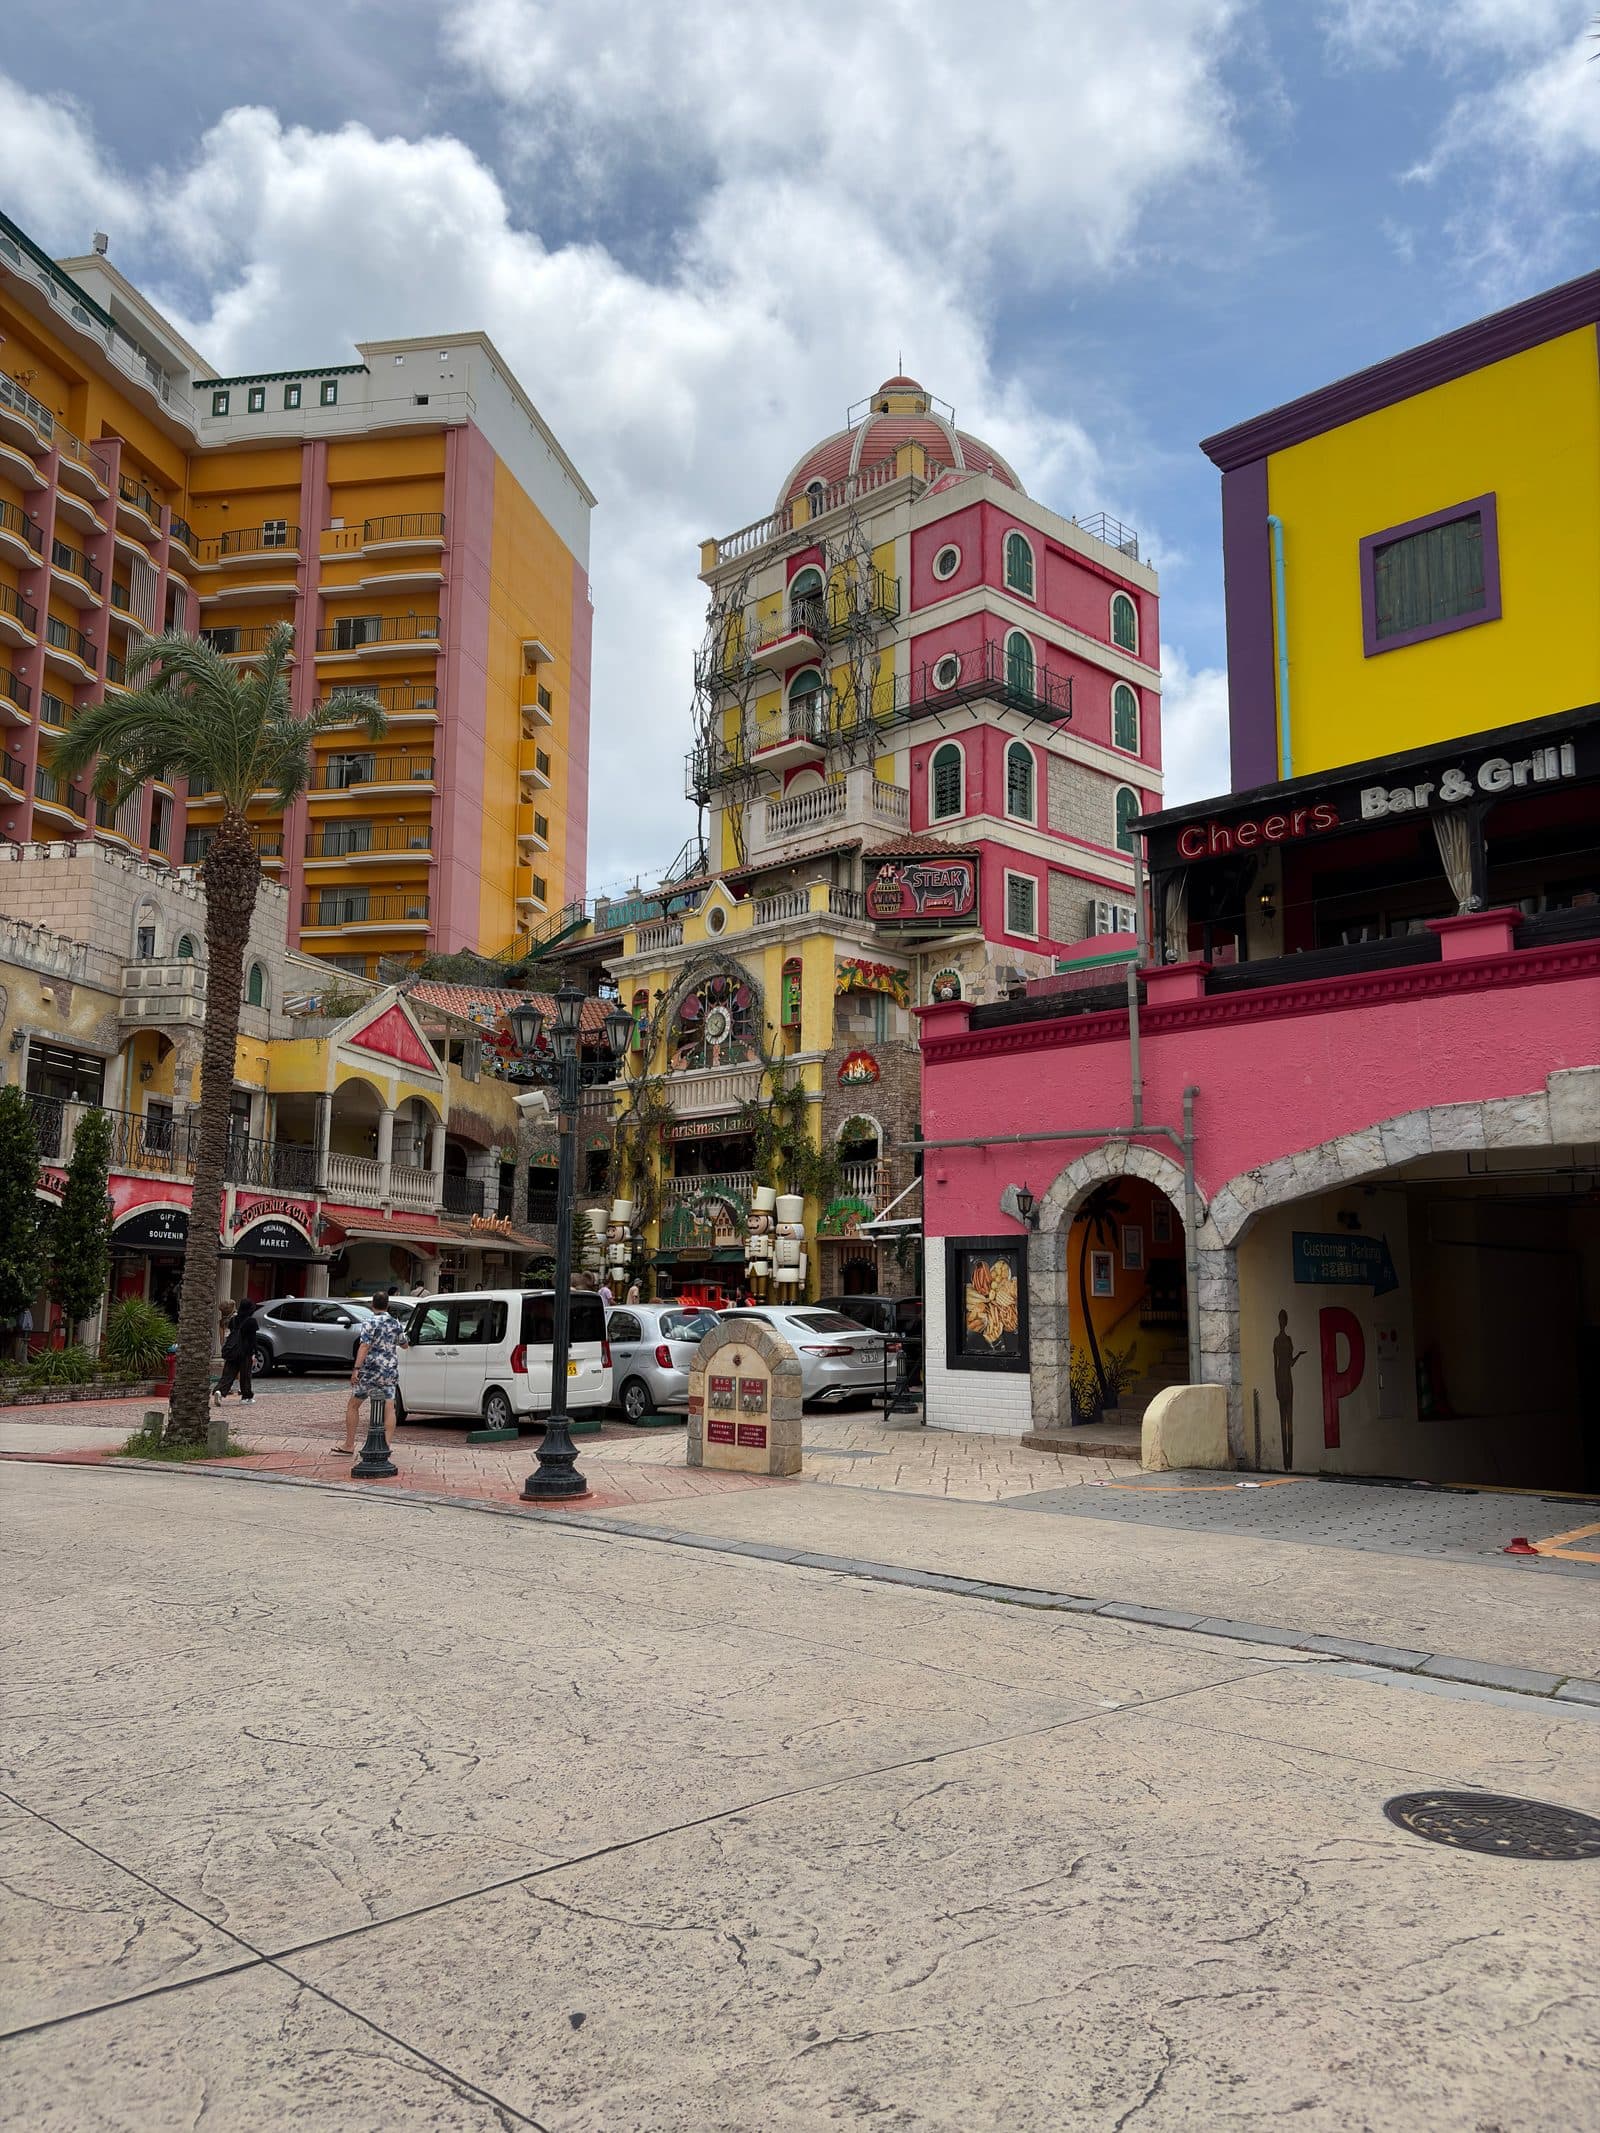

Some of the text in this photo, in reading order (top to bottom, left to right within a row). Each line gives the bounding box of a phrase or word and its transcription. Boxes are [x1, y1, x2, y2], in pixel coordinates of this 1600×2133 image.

[1177, 743, 1576, 860] Cheers Bar & Grill
[879, 864, 896, 878] 4F
[913, 870, 962, 887] STEAK
[873, 891, 902, 904] WINE
[160, 1213, 176, 1222] GIFT
[241, 1199, 285, 1225] SOUVENIR
[149, 1230, 184, 1240] SOUVENIR
[262, 1223, 286, 1235] OKINAWA
[260, 1238, 289, 1248] MARKET
[1303, 1240, 1346, 1257] Customer
[1319, 1306, 1365, 1449] P
